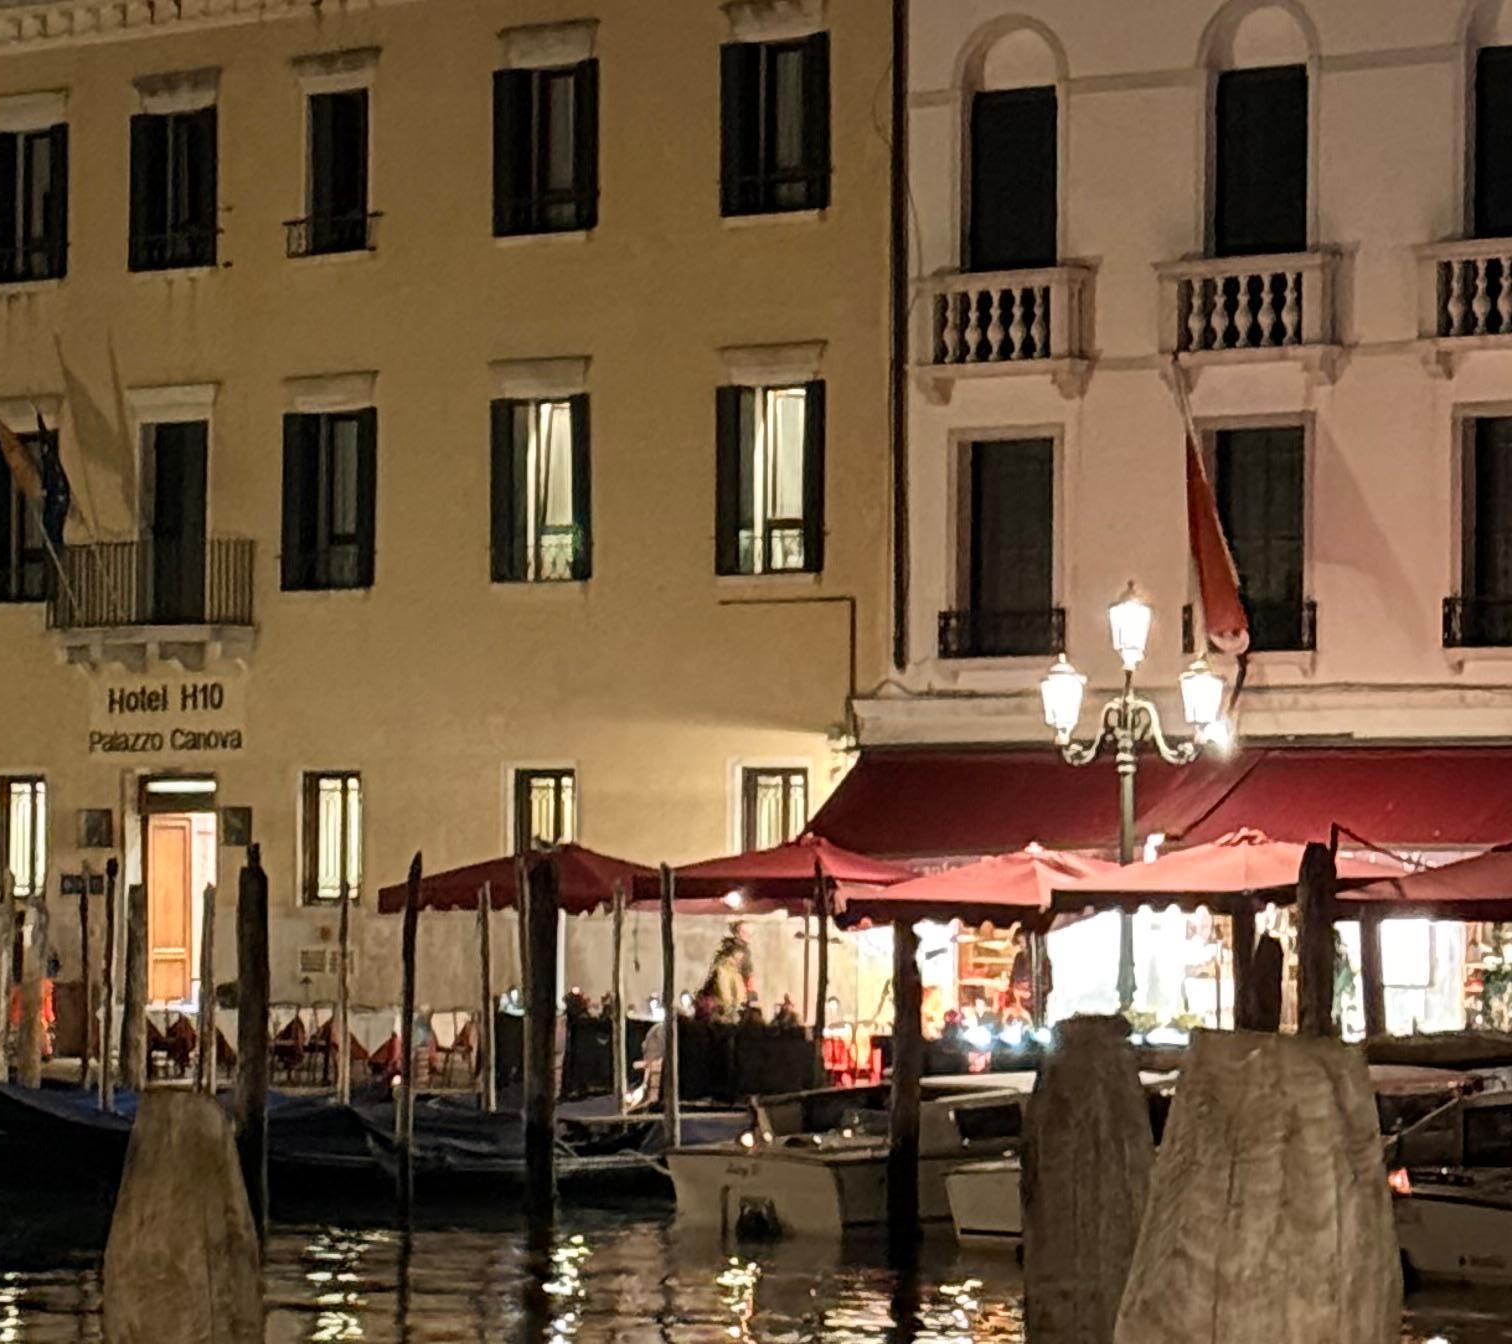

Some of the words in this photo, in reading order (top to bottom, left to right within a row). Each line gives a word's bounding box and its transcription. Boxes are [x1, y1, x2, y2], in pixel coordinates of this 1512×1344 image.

[107, 685, 168, 714] Hotel
[180, 682, 224, 711] H10
[89, 730, 164, 753] Palazzo
[170, 727, 243, 751] Canova
